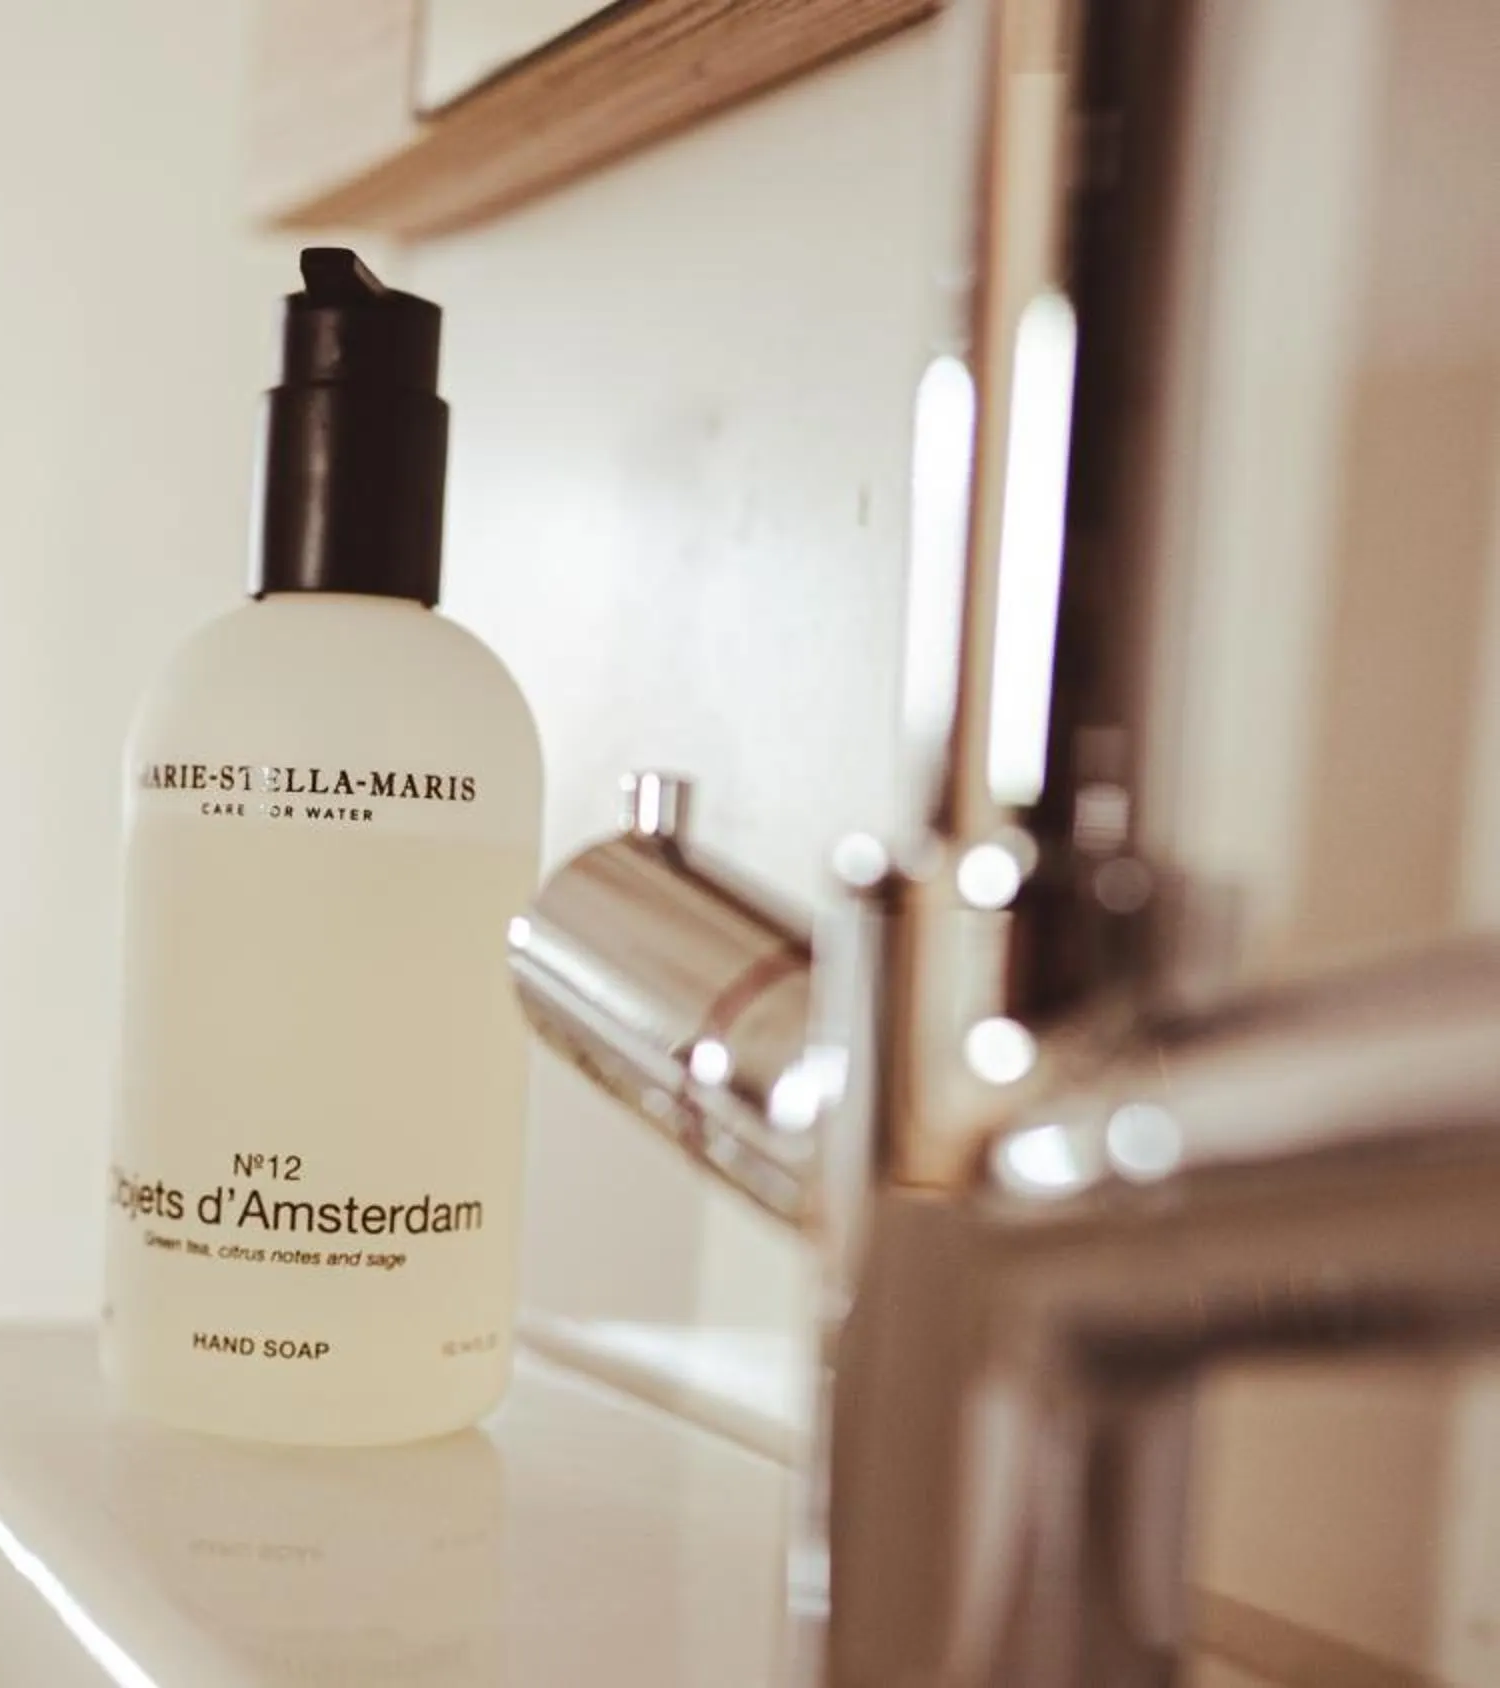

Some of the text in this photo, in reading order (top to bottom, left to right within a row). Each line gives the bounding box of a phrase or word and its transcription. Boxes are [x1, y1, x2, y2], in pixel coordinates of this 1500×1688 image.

[201, 801, 373, 822] CARE OR WATER
[197, 1185, 482, 1236] d’Amsterdam
[217, 1245, 266, 1263] citrus
[270, 1249, 321, 1265] notes
[326, 1250, 363, 1267] and
[366, 1252, 407, 1271] sage
[193, 1332, 331, 1360] HAND SOAP
